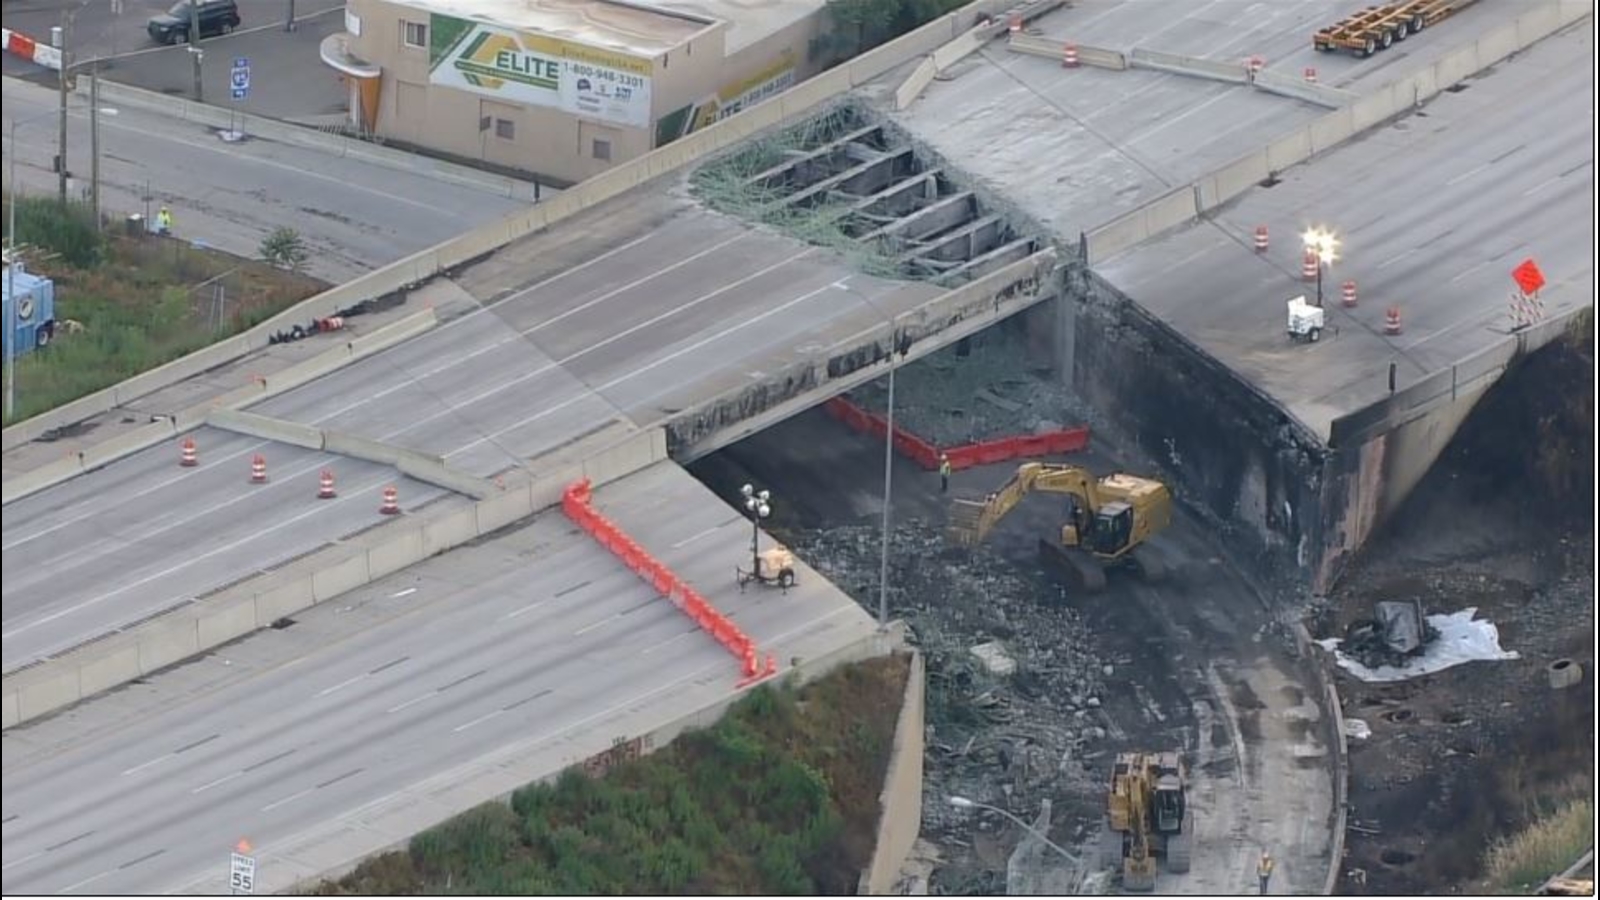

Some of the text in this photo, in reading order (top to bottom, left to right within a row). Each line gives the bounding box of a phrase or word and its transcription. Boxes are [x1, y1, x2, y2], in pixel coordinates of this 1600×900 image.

[496, 51, 559, 79] ELITE
[563, 61, 643, 88] 1-800-948-3301
[232, 872, 251, 890] 55
